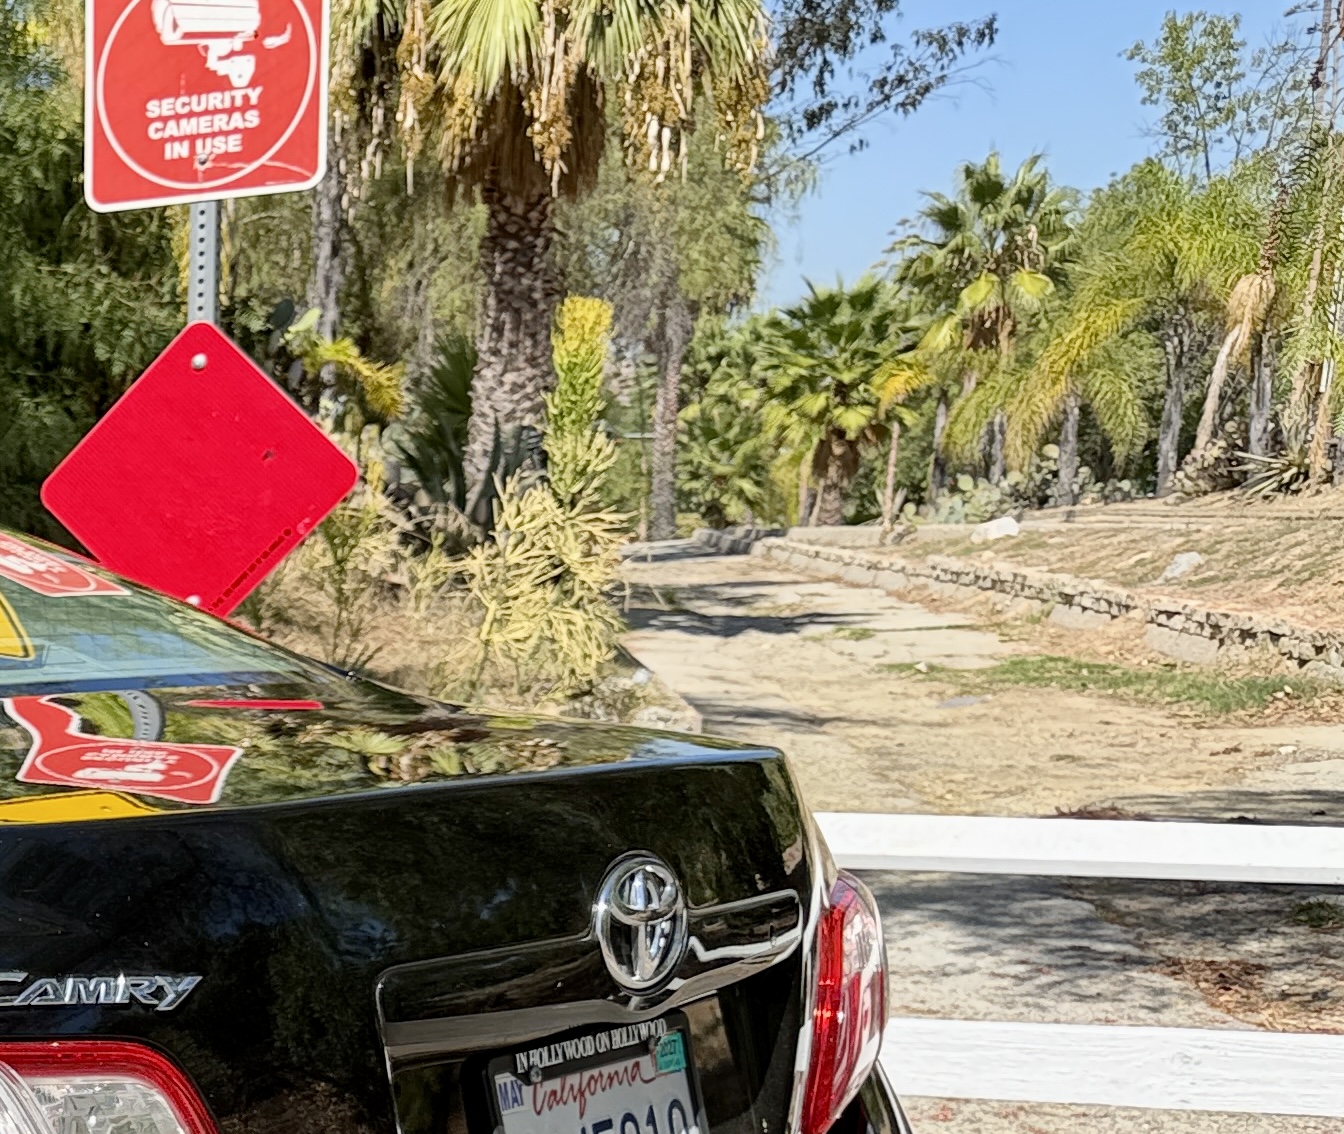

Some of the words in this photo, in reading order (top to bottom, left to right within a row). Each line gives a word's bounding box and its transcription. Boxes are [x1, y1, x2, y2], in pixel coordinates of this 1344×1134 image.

[146, 87, 262, 118] SECURITY
[147, 109, 260, 140] CAMERAS
[164, 139, 189, 160] IN
[195, 133, 243, 158] USE
[515, 1050, 529, 1074] IN
[528, 1035, 595, 1069] HOLLYWOOD
[595, 1031, 611, 1053] ON
[611, 1018, 667, 1051] HOLLYWOOD
[497, 1076, 524, 1111] MAY
[531, 1060, 655, 1120] California
